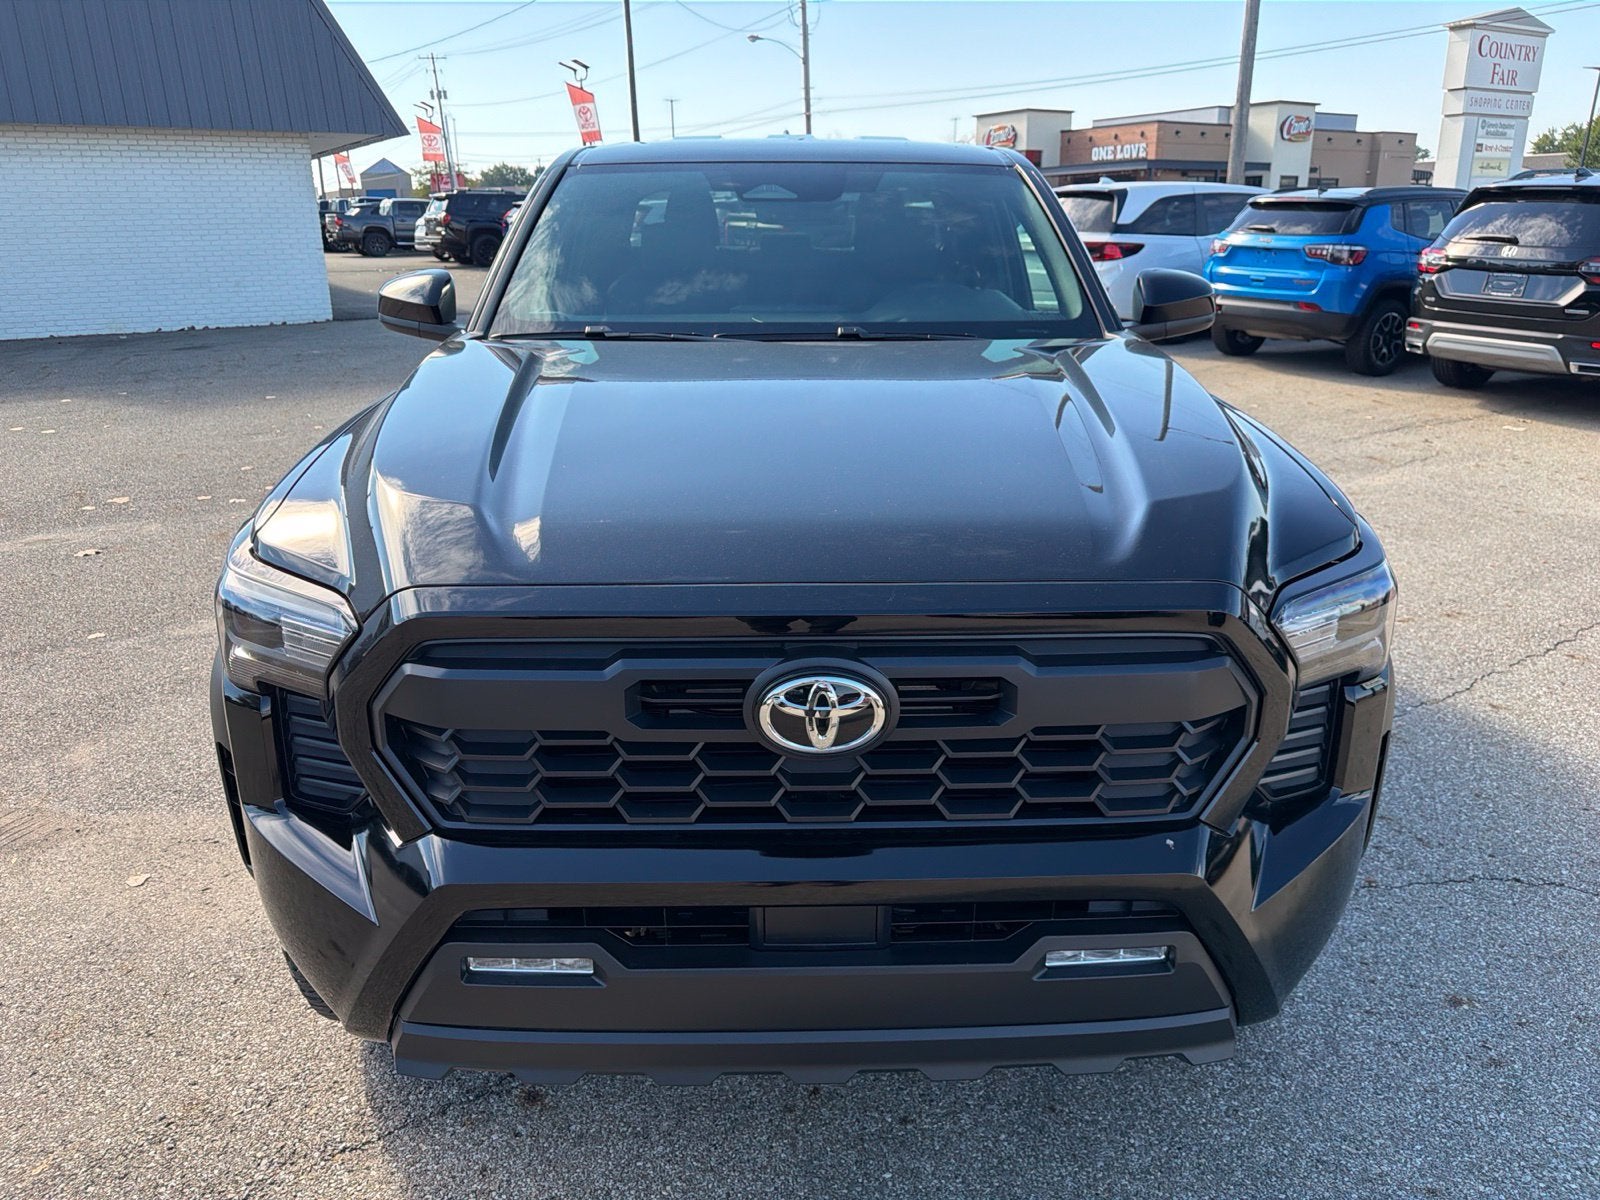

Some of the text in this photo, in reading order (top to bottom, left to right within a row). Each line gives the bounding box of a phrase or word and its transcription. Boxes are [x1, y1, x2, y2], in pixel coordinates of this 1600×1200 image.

[1478, 35, 1539, 62] COUNTRY
[1490, 62, 1518, 86] FAIR
[1469, 96, 1531, 111] SHOPPING CENTER
[1091, 142, 1147, 161] ONE LOVE
